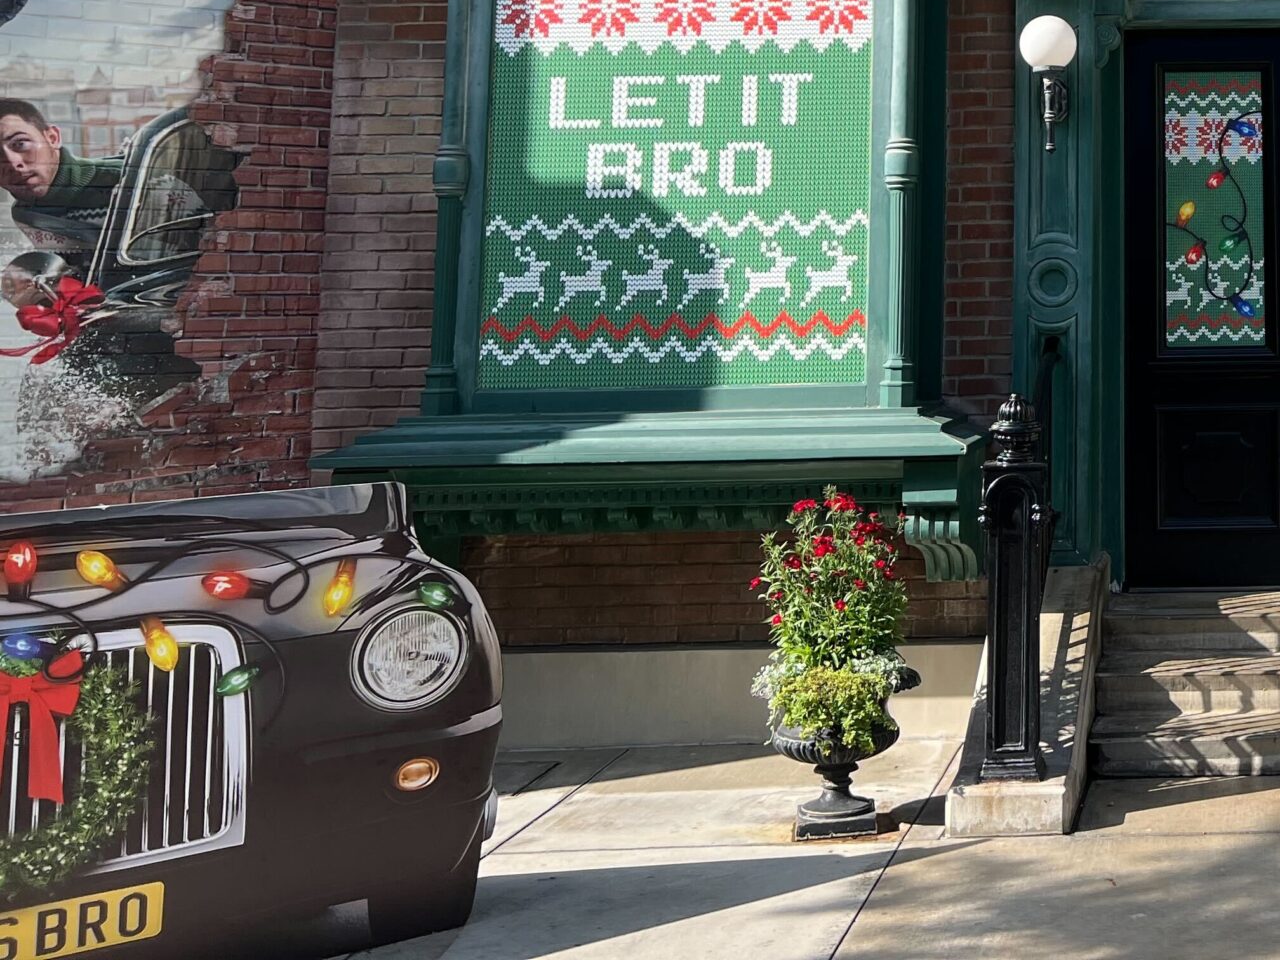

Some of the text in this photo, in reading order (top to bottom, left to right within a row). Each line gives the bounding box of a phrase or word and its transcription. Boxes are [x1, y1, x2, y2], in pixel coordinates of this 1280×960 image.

[549, 73, 813, 129] LET IT
[585, 141, 773, 199] BRO
